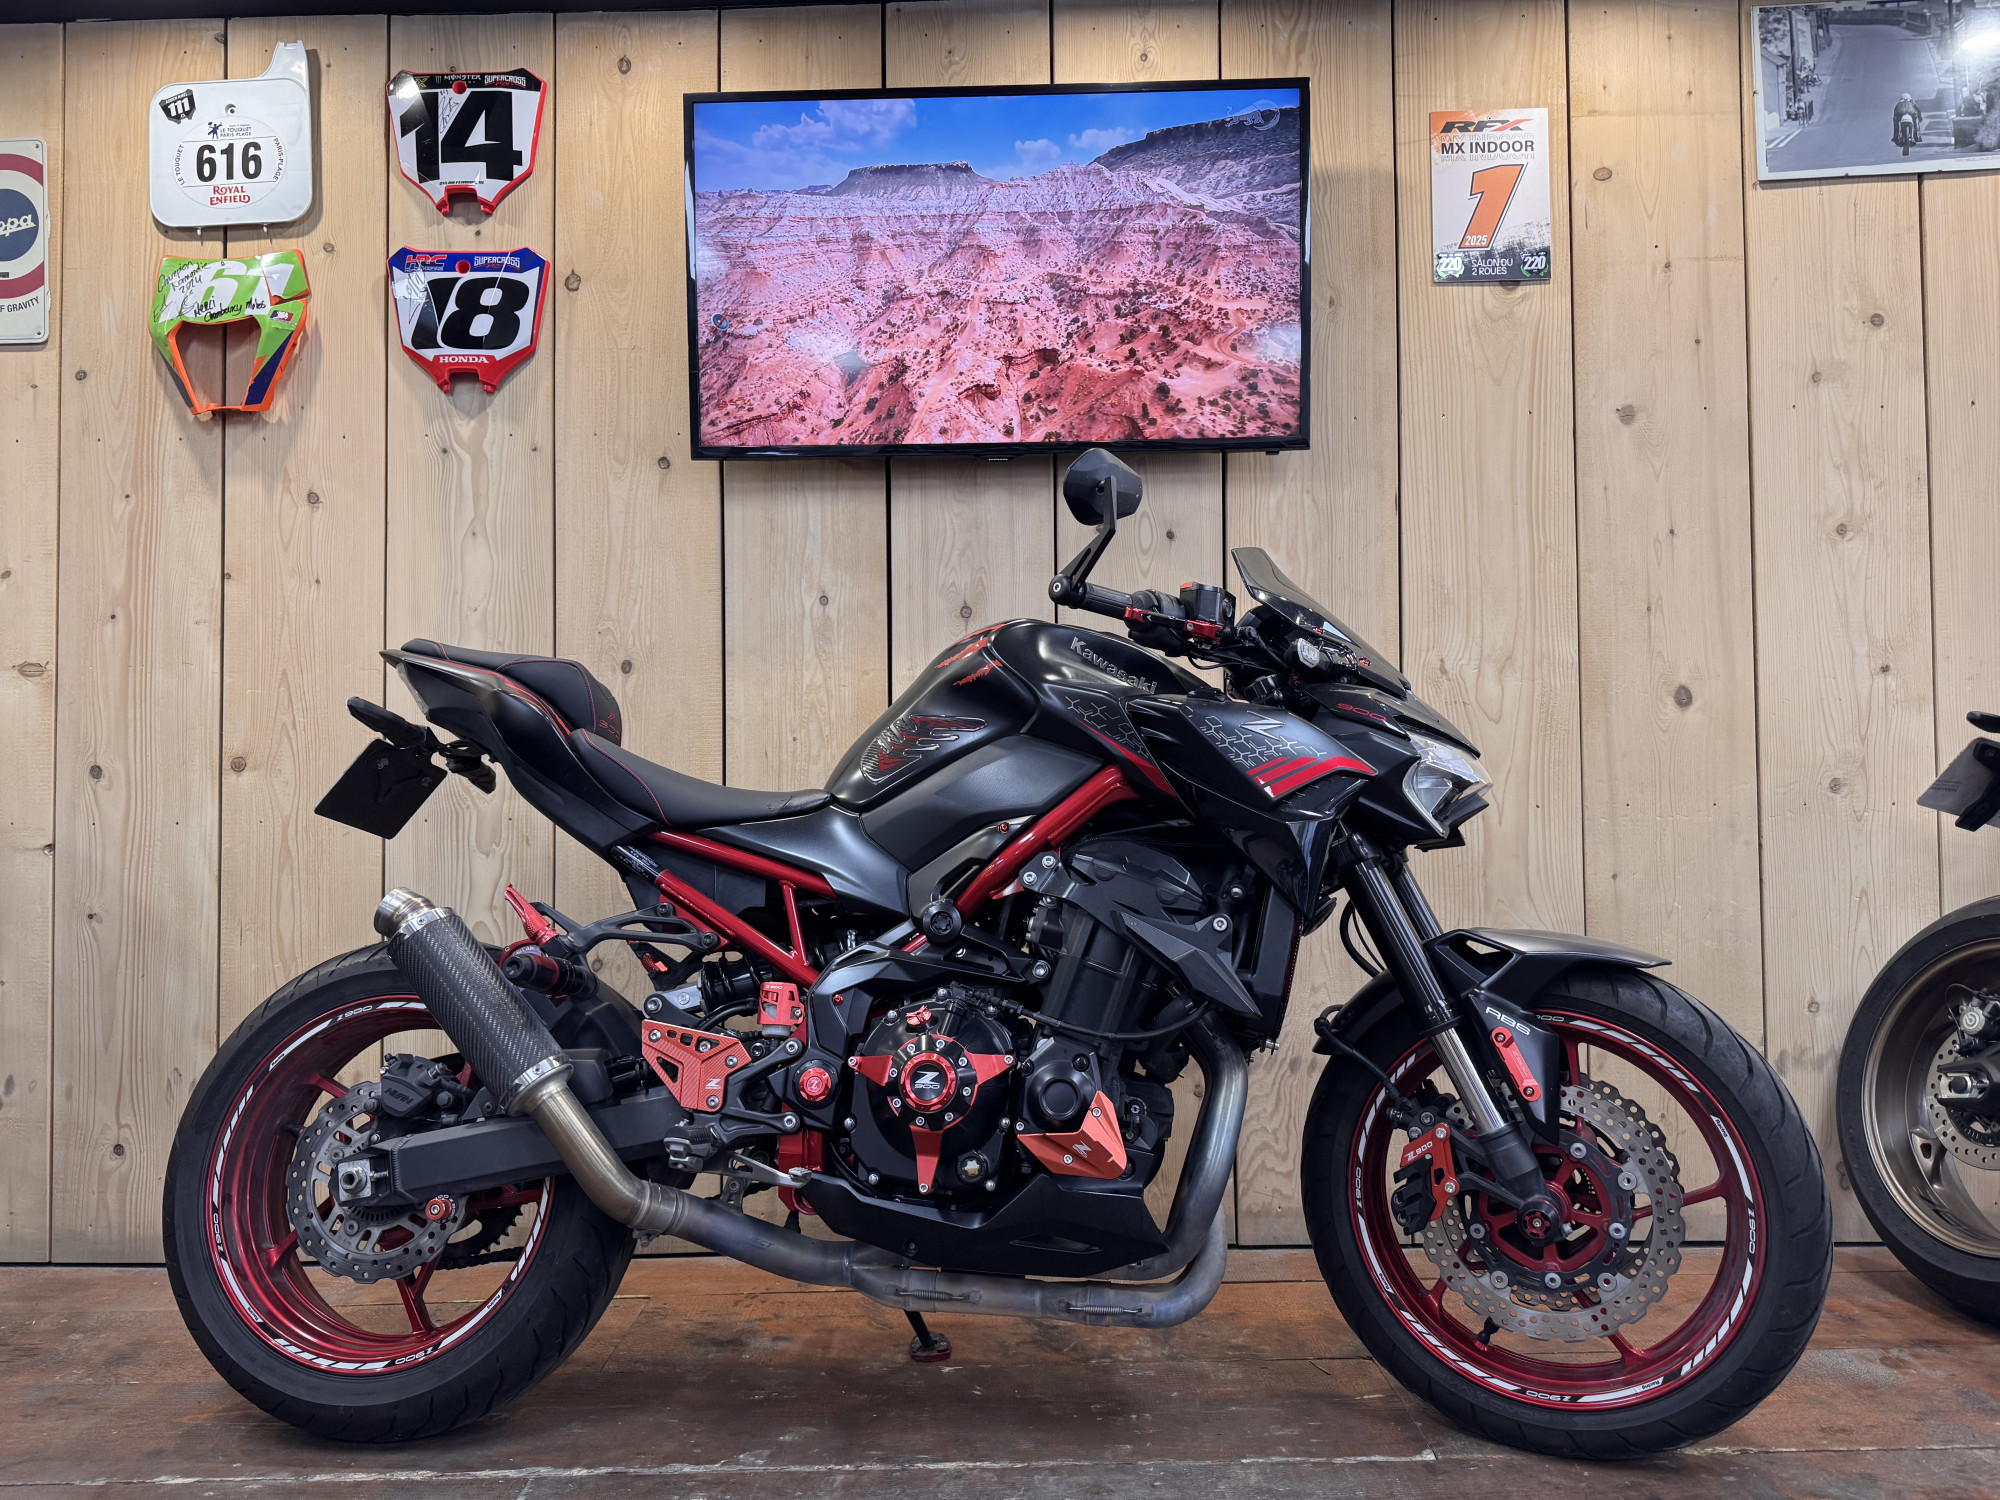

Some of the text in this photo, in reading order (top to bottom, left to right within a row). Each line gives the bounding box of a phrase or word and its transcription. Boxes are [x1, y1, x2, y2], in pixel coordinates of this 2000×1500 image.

[484, 74, 527, 87] SUPERCROSS
[167, 97, 190, 117] 111
[1440, 119, 1533, 134] RFX
[400, 91, 523, 184] 14
[1441, 140, 1535, 155] MX INDOOR
[174, 144, 185, 186] LE TOUQUET
[195, 141, 262, 183] 616
[273, 137, 284, 181] PARIS-PLAGE
[209, 194, 251, 206] ENFIELD
[213, 186, 246, 196] ROYAL
[1458, 163, 1526, 250] 1
[1464, 234, 1488, 246] 2025
[404, 254, 448, 270] HRC
[474, 255, 521, 269] SUPERCROSS
[1439, 256, 1463, 272] 220
[1471, 258, 1513, 268] SALON DU
[1523, 255, 1547, 271] 220
[1471, 267, 1508, 276] 2 ROUES
[7, 295, 40, 314] GRAVITY
[411, 276, 530, 350] 18
[439, 355, 490, 364] HONDA
[1070, 636, 1158, 695] Kawasaki
[1336, 702, 1388, 722] 900
[335, 1004, 374, 1022] Z900
[1485, 1006, 1531, 1036] ABS
[914, 1070, 940, 1085] Z
[1714, 1118, 1729, 1138] Racing
[1355, 1166, 1363, 1209] Z900
[212, 1211, 225, 1253] Z900
[1747, 1207, 1756, 1254] Z900
[394, 1346, 434, 1366] Z900
[1525, 1389, 1572, 1402] Z900
